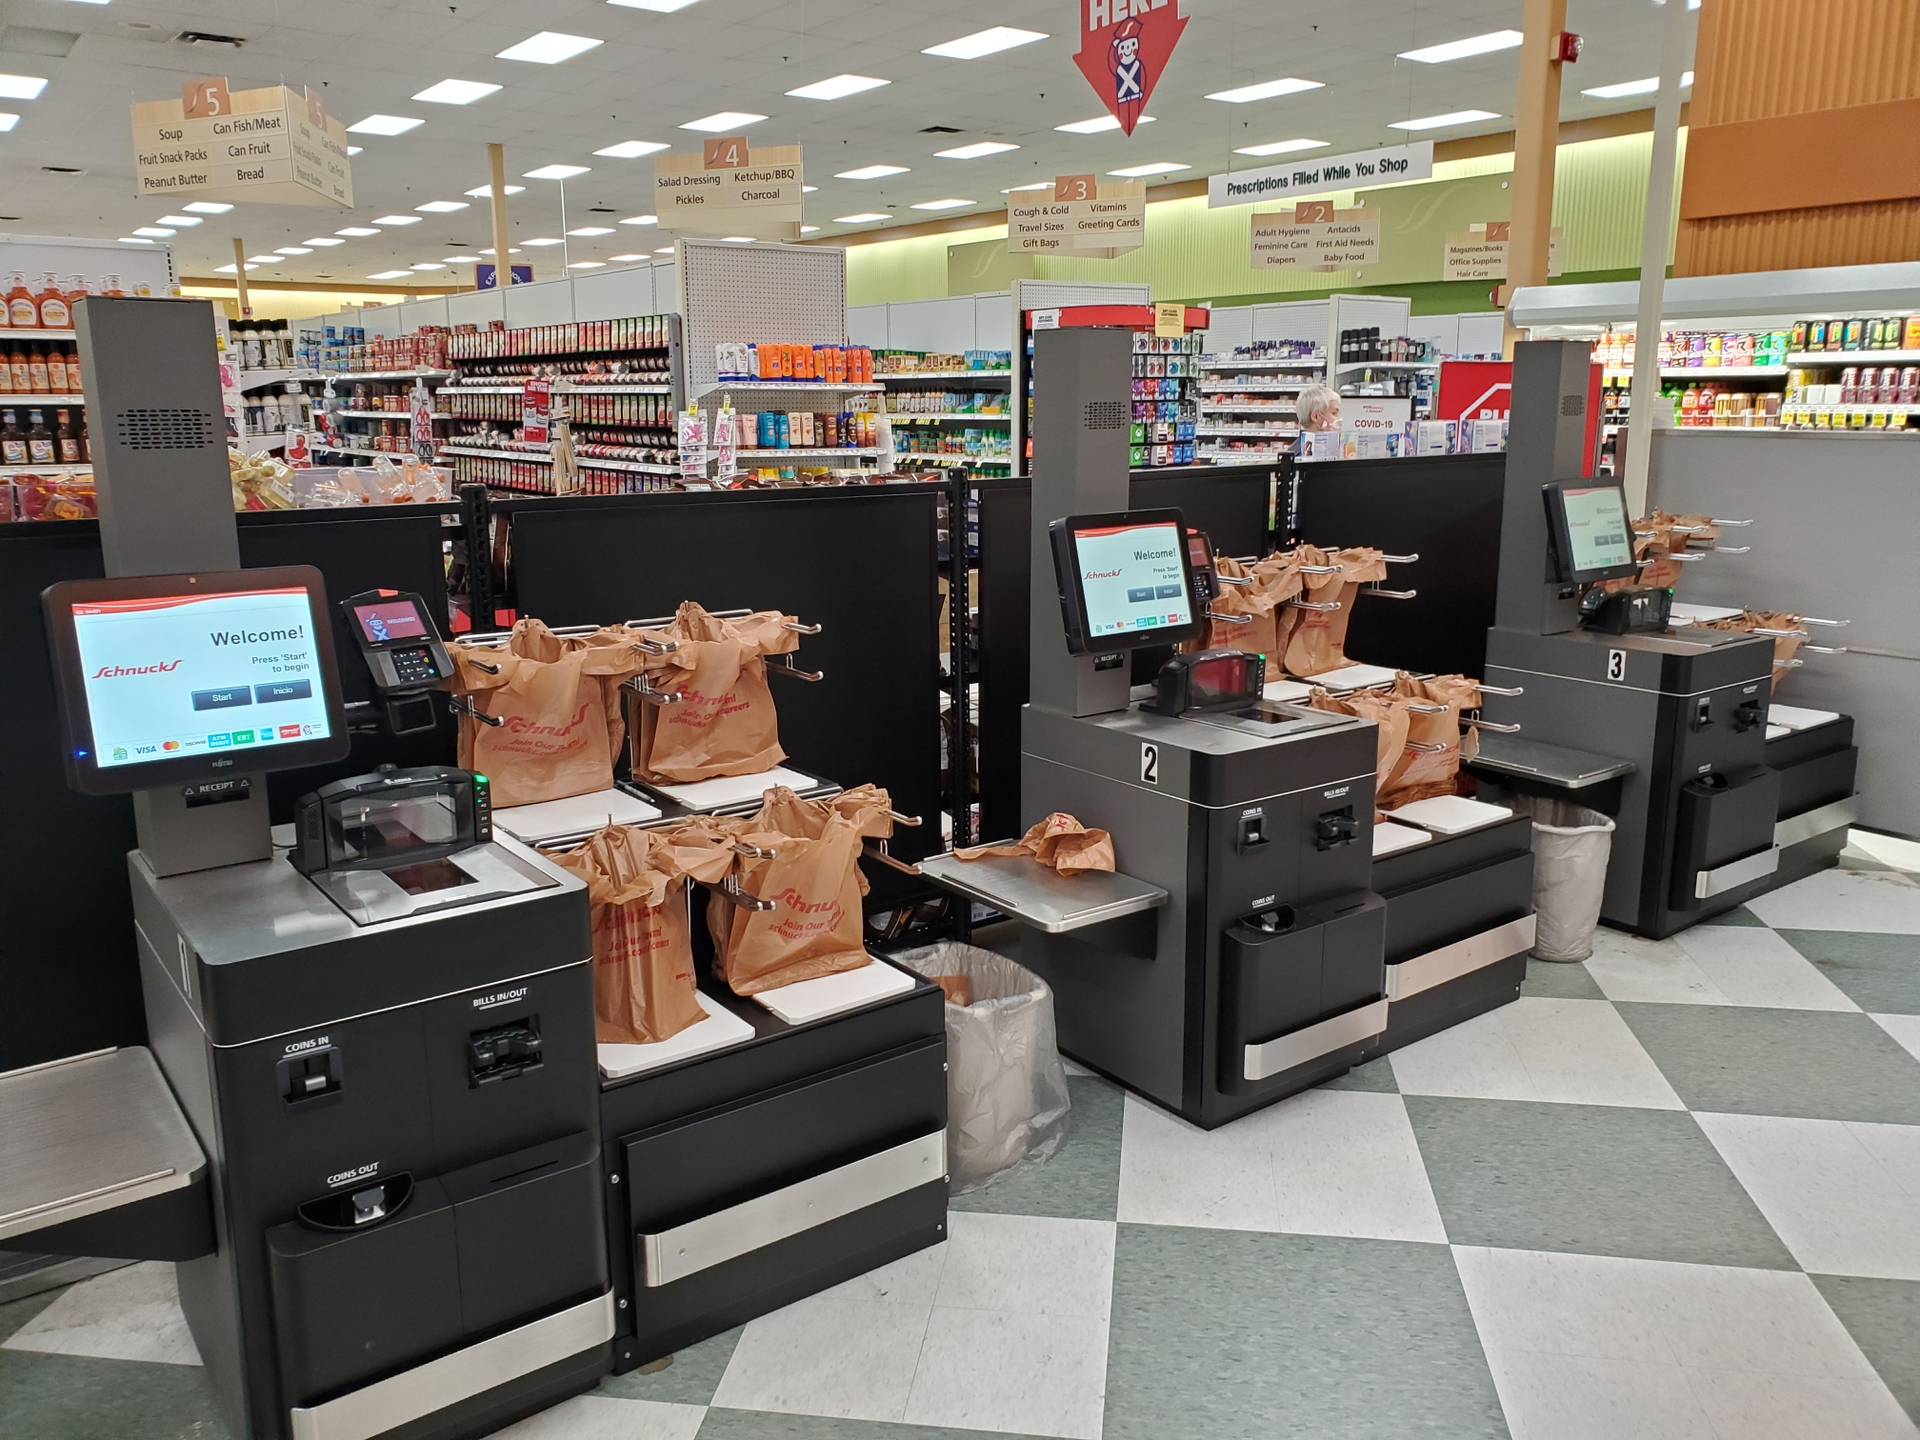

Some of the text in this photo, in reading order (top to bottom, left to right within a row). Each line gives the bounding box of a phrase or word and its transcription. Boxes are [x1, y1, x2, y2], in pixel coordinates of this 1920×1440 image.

[1089, 0, 1168, 31] HE
[206, 88, 220, 116] 5
[213, 117, 281, 136] Can Fish/Meat
[159, 129, 183, 141] Soup
[228, 142, 271, 157] Can Fruit
[725, 144, 740, 167] 4
[139, 149, 208, 166] Fruit Snack Packs
[237, 167, 264, 181] Bread
[734, 168, 795, 183] Ketchup/BBQ
[1227, 156, 1408, 196] Prescriptions Filled While You Shop
[144, 173, 208, 189] Peanut Butter
[658, 174, 721, 188] Salad Dressing
[741, 188, 780, 201] Charcoal
[1075, 181, 1087, 200] 3
[676, 194, 705, 205] Pickles
[1013, 205, 1070, 218] Cough & Cold
[1090, 202, 1127, 213] Vitamins
[1314, 205, 1326, 223] 2
[1018, 222, 1065, 233] Travel Sizes
[1078, 218, 1140, 230] Greeting Cards
[1327, 225, 1361, 234] Antacids
[1255, 227, 1310, 238] Adult Hygiene
[1022, 238, 1060, 248] Gift Bags
[1254, 241, 1308, 250] Feminine Care
[1316, 238, 1374, 248] First Aid Needs
[1450, 245, 1503, 255] Magazines/Books
[1267, 256, 1296, 265] Diapers
[1323, 252, 1365, 264] Baby Food
[1449, 257, 1502, 266] Office Supplies
[1456, 269, 1489, 278] Hair Care
[1354, 419, 1393, 428] COVID-19
[1133, 548, 1176, 561] Welcome!
[1084, 568, 1123, 580] Schnucks
[210, 625, 305, 647] Welcome!
[252, 655, 279, 666] Press
[1101, 654, 1117, 662] RECEIPT
[91, 659, 183, 679] Schnucks
[272, 662, 310, 674] to begin
[1611, 652, 1622, 678] 3
[273, 686, 293, 695] Inicio
[212, 692, 233, 702] Start
[136, 745, 157, 755] VISA
[535, 741, 554, 750] Our
[212, 758, 233, 768] FUJITSU
[1144, 746, 1156, 782] 2
[199, 781, 234, 794] RECEIPT
[1324, 789, 1334, 797] BILLS
[1242, 808, 1256, 816] COINS
[1252, 897, 1266, 906] COINS
[783, 918, 825, 931] Join Our
[473, 987, 528, 1007] BILLS IN/OUT
[285, 1035, 329, 1053] COINS IN
[327, 1162, 379, 1184] COINS OUT
